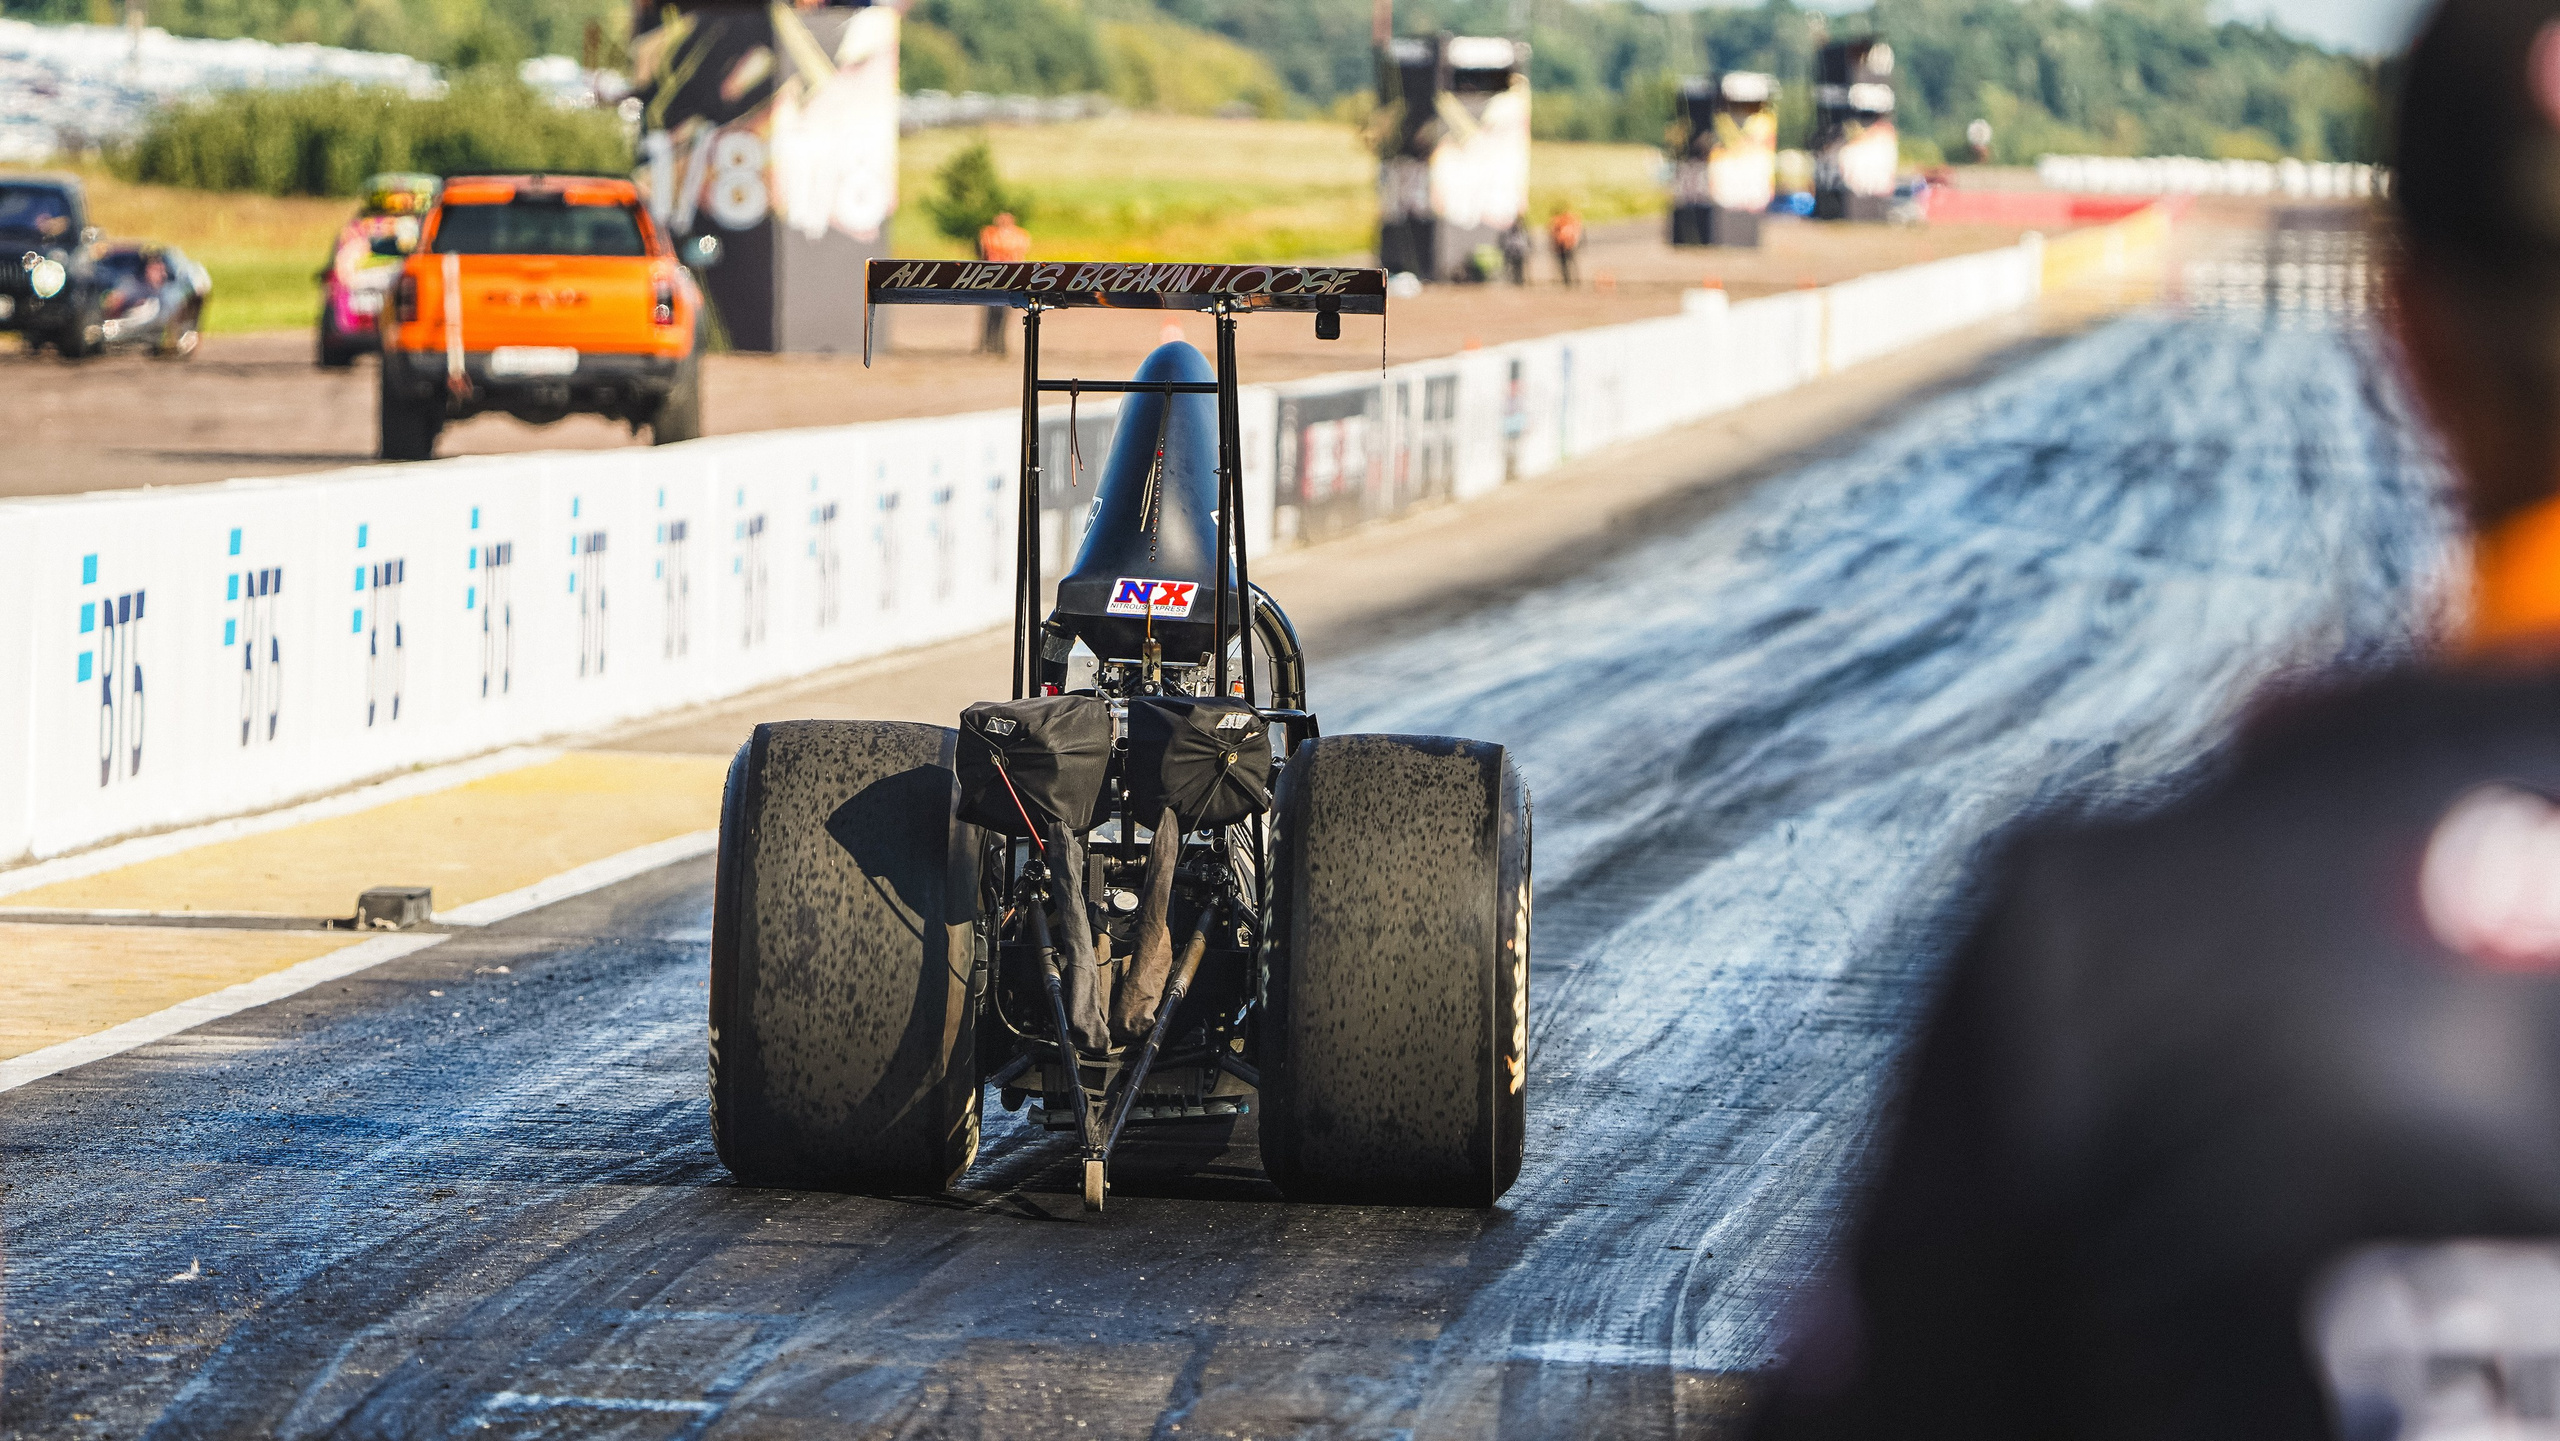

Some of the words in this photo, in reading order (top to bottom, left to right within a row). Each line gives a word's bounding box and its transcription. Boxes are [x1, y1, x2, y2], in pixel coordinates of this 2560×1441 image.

[880, 262, 941, 288] ALL
[951, 262, 1065, 292] HELL'S
[1066, 262, 1213, 293] BREAKIN'
[1208, 265, 1359, 295] LOOSE
[1113, 580, 1195, 606] NX
[1110, 603, 1147, 611] NITROUS
[1150, 604, 1187, 612] EXPRESS
